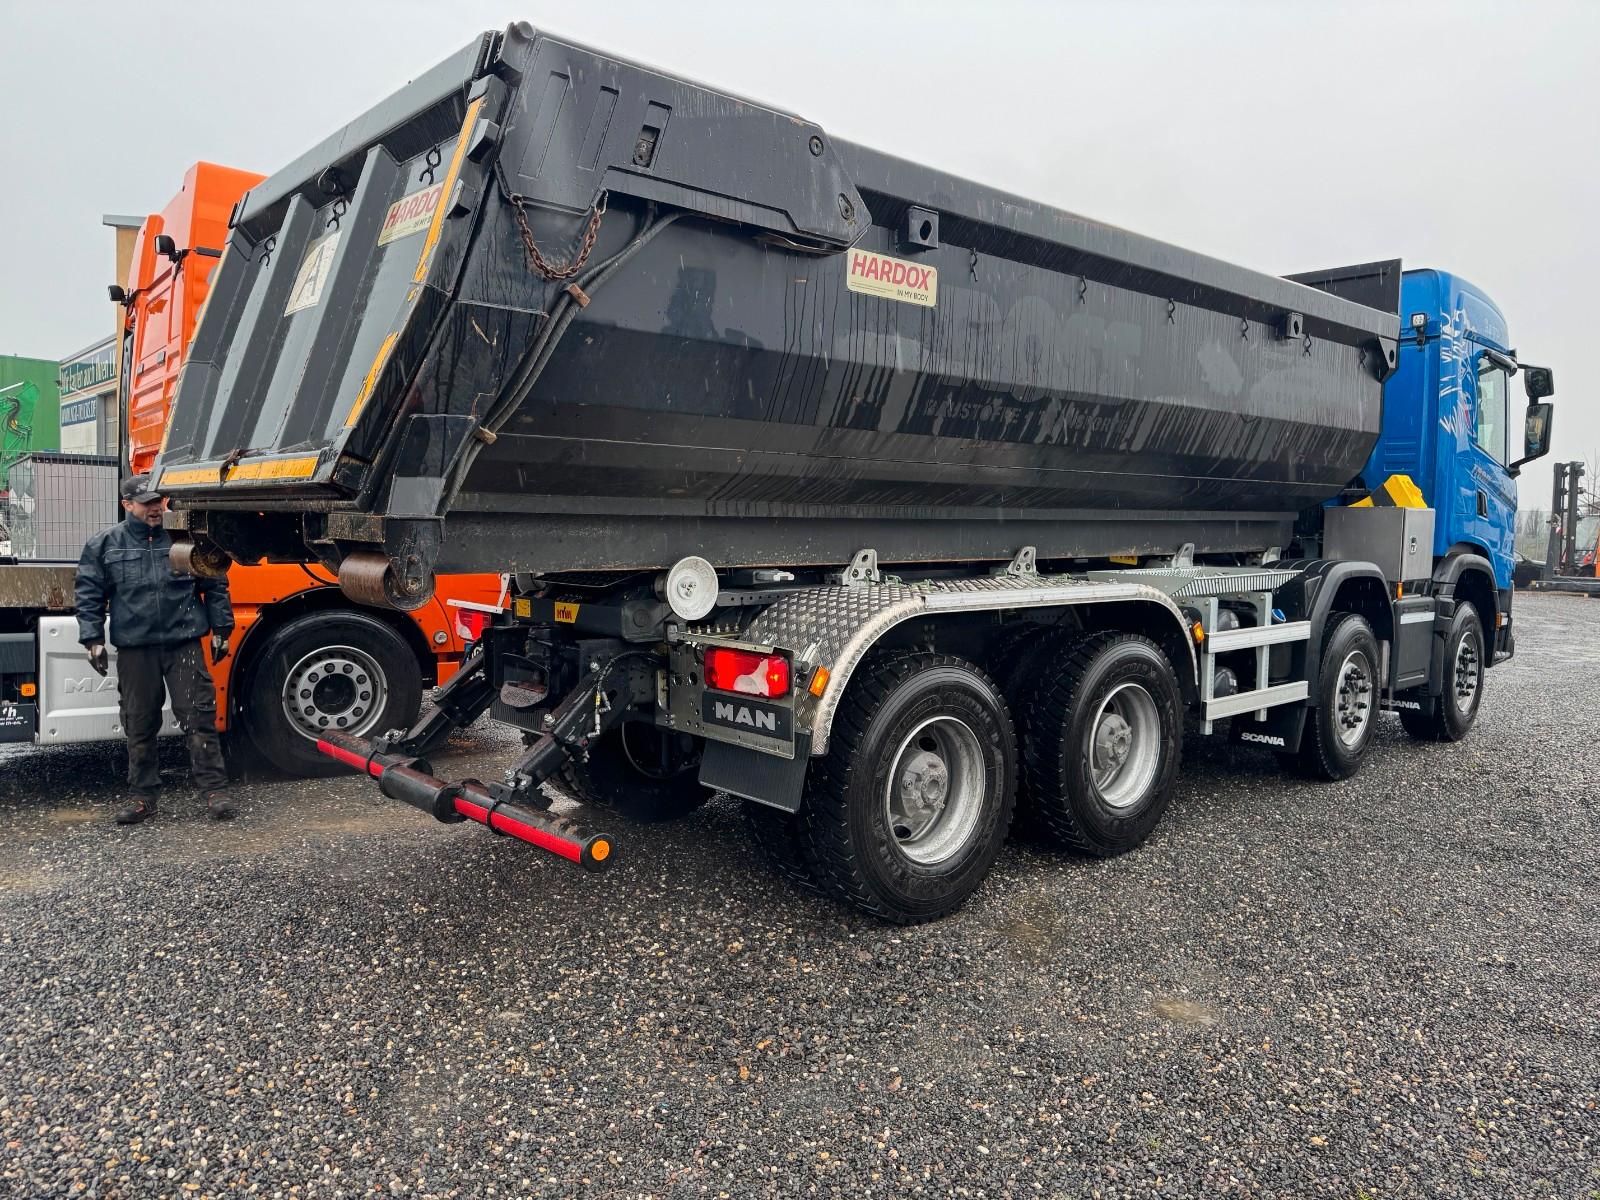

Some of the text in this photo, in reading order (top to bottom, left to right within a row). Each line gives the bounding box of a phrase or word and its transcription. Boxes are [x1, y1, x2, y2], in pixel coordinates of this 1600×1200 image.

[384, 187, 442, 230] HARDO
[295, 244, 325, 303] A
[851, 252, 931, 291] HARDOX
[897, 289, 929, 302] IN MY BODY
[84, 356, 95, 386] auch
[64, 677, 118, 694] MA
[715, 701, 776, 731] MAN
[1380, 699, 1421, 710] SCANIA
[1240, 732, 1286, 747] SCANIA
